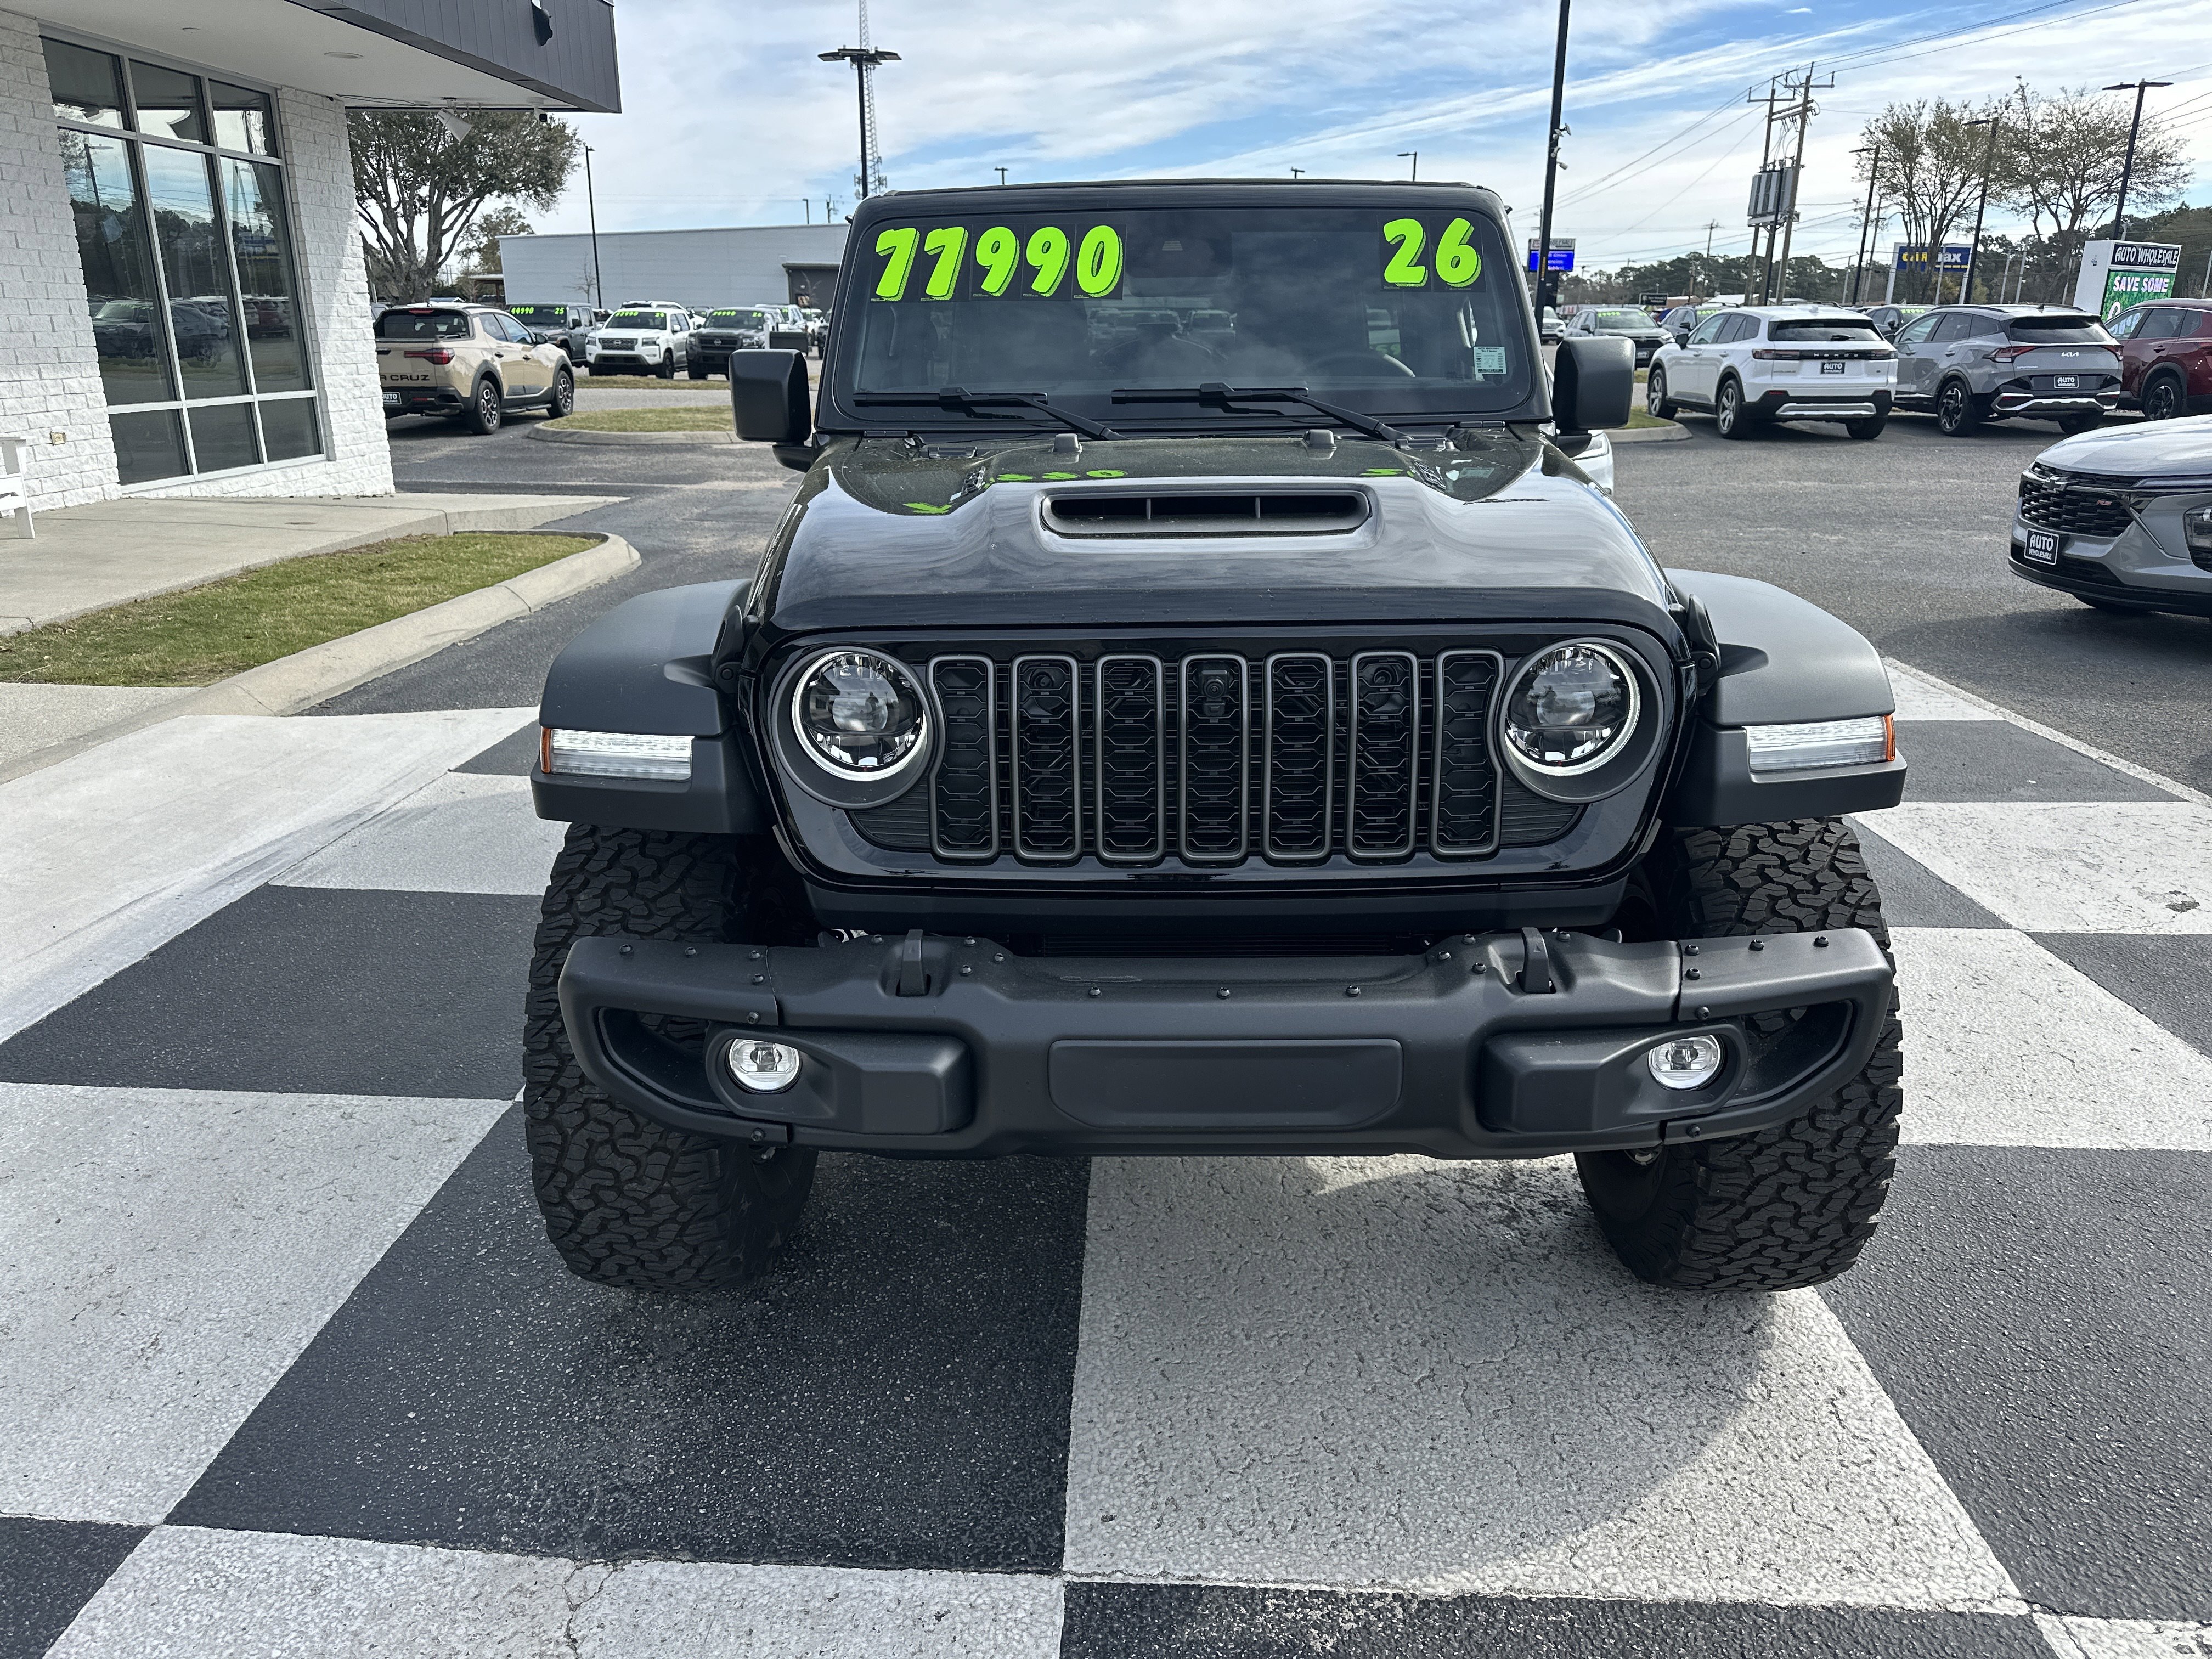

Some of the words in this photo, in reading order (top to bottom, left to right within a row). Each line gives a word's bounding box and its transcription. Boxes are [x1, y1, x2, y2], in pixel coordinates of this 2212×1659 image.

[1383, 217, 1482, 287] 26
[2115, 246, 2137, 263] AUTO
[2138, 248, 2179, 266] WHOLESALE
[876, 225, 1123, 301] 77990
[2113, 276, 2141, 292] SAVE
[2141, 277, 2169, 293] SOME
[2029, 534, 2054, 551] AUTO
[2029, 548, 2052, 560] WHOLESALE
